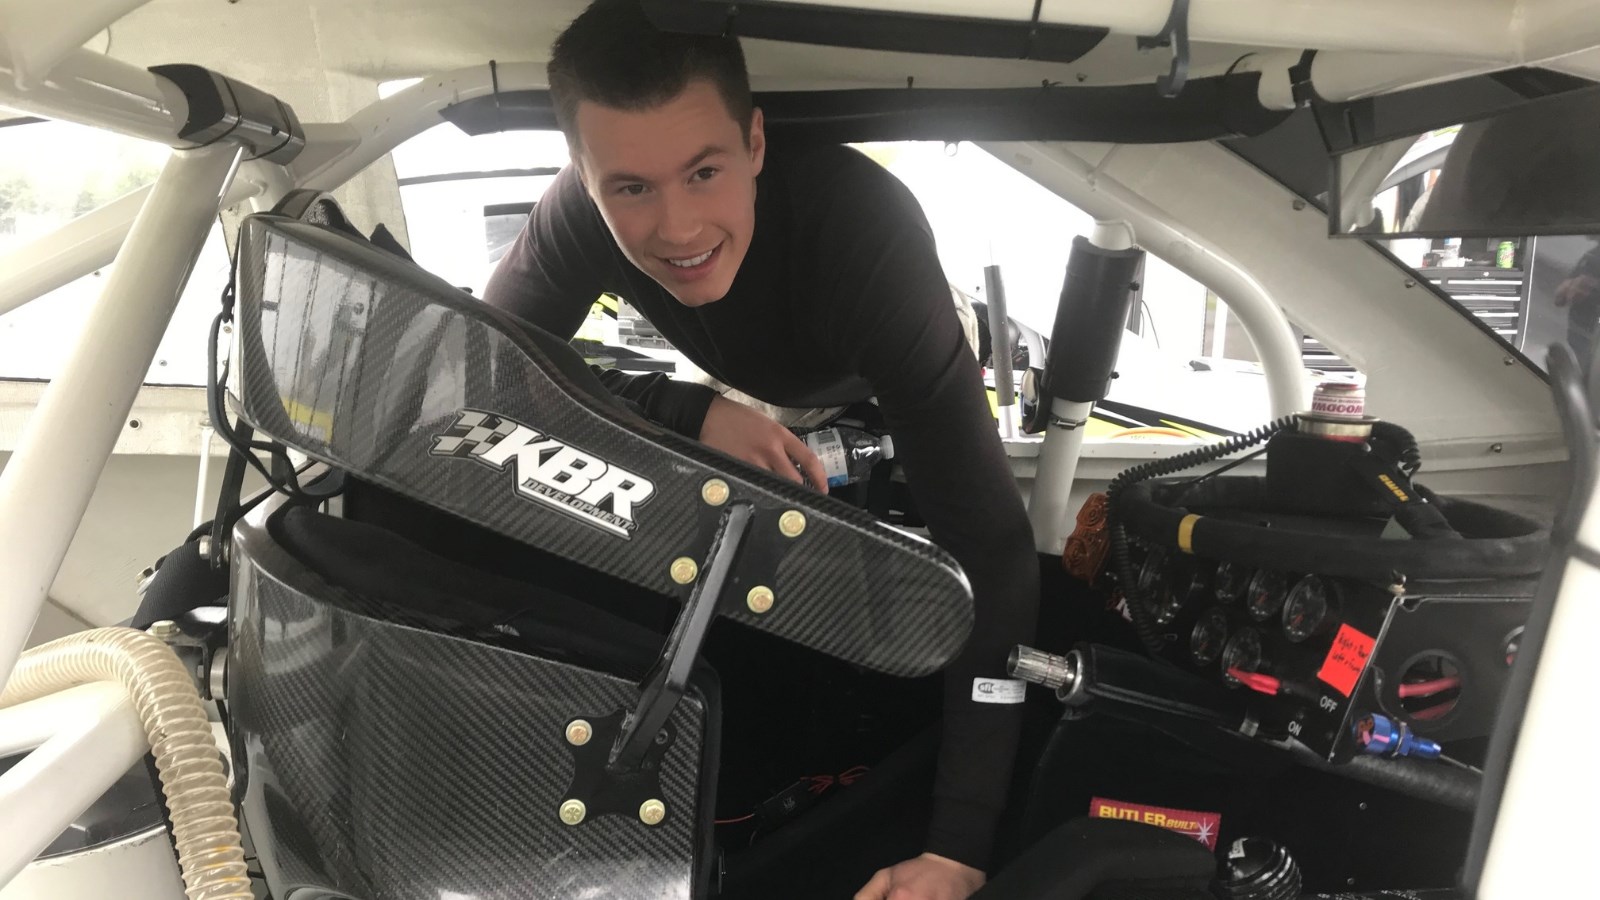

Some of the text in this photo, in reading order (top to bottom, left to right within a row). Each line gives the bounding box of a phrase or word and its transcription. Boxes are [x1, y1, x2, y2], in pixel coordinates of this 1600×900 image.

[478, 424, 655, 522] KBR
[521, 477, 636, 531] DEVELOPMENT
[1320, 695, 1338, 712] OFF
[1288, 721, 1302, 736] ON
